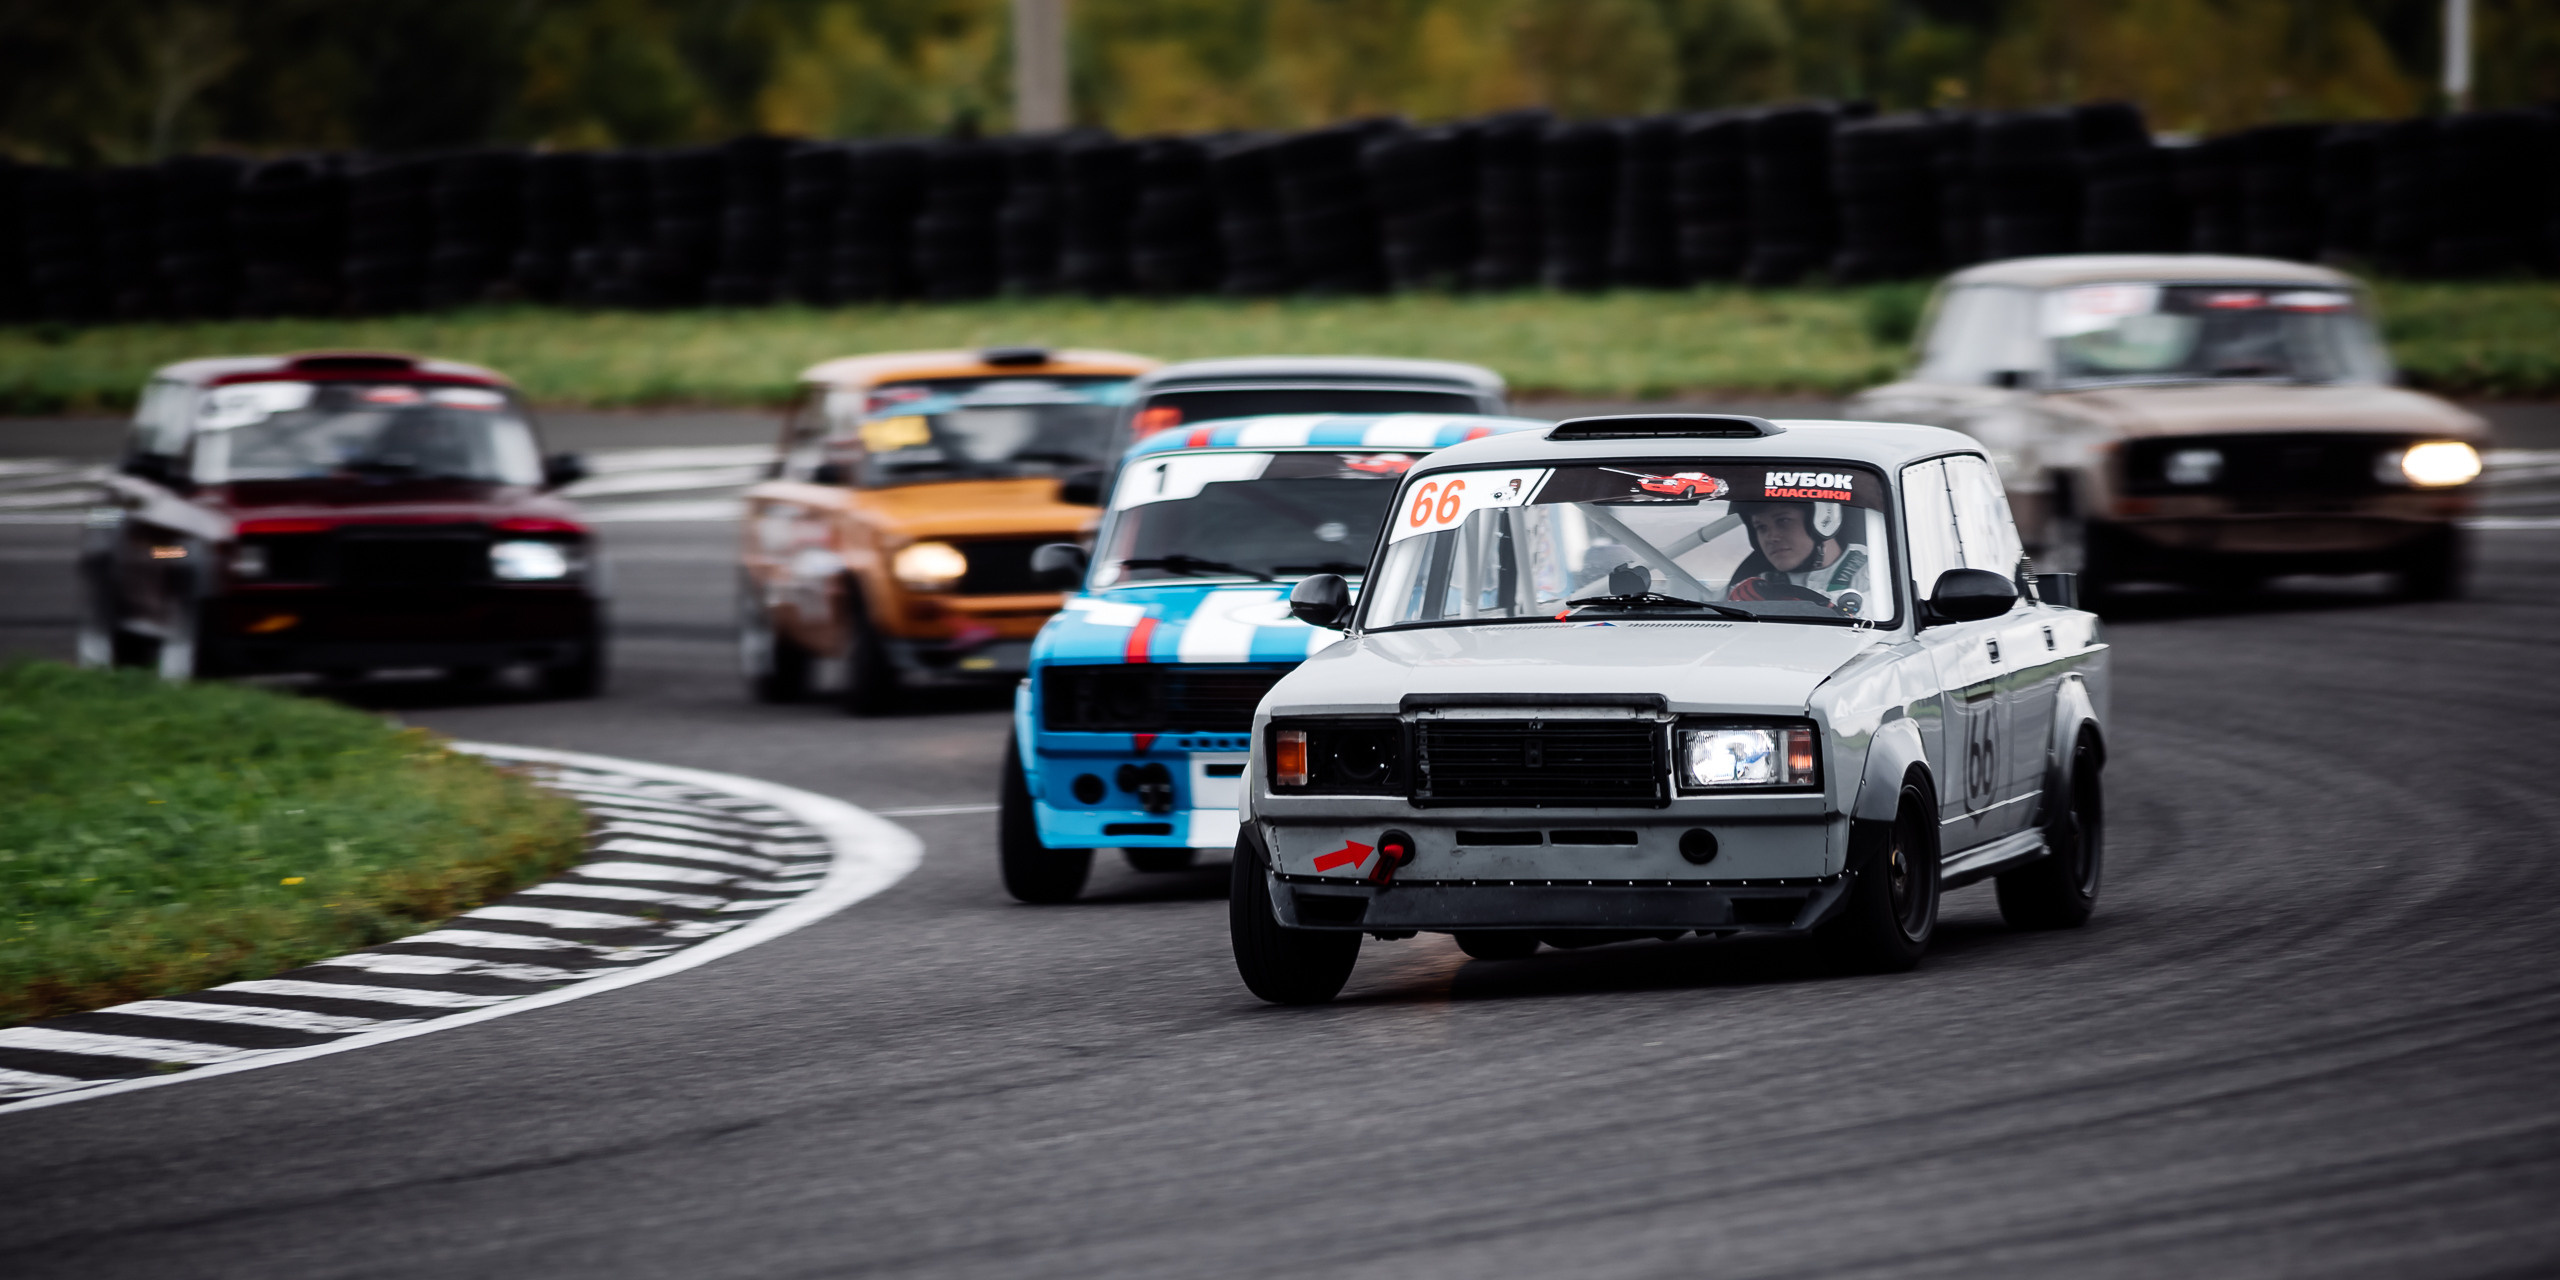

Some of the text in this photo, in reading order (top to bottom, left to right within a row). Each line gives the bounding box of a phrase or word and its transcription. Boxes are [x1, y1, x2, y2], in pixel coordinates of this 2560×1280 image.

[1156, 463, 1169, 495] 1
[1765, 472, 1853, 489] КУБОК
[1765, 488, 1851, 501] КЛАССИКИ
[1410, 480, 1465, 528] 66
[1969, 708, 1995, 800] 66
